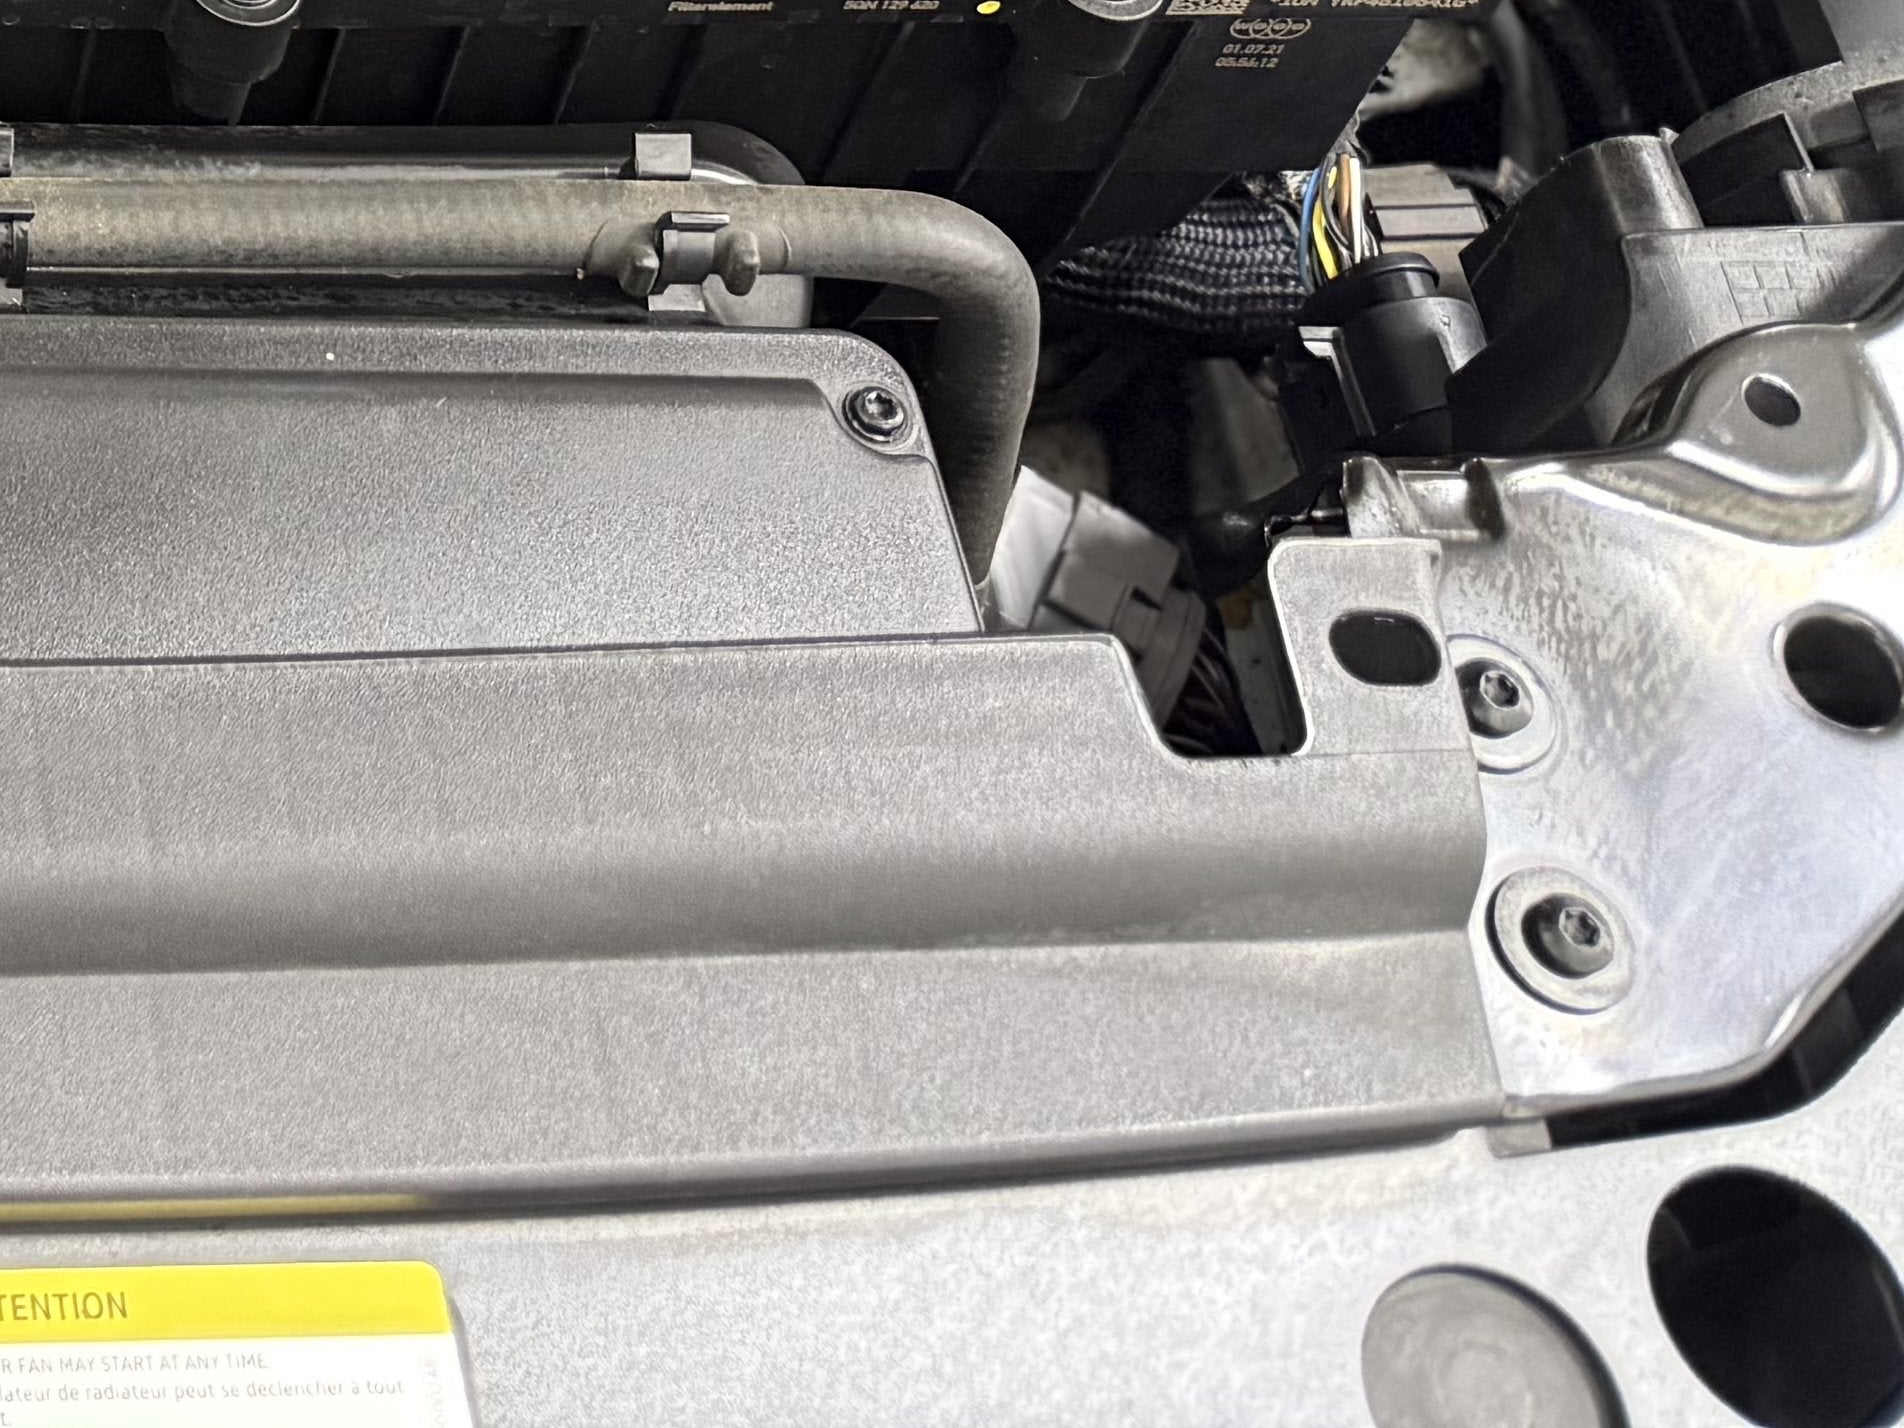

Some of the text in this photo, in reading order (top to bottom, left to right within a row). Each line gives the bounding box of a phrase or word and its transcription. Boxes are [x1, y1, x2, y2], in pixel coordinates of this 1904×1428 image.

[18, 1356, 53, 1375] FAN
[59, 1355, 95, 1374] MAY
[101, 1354, 153, 1372] START
[159, 1354, 180, 1372] AT
[185, 1353, 219, 1371] ANY
[58, 1383, 80, 1402] de
[85, 1380, 168, 1401] radiateur
[173, 1382, 217, 1403] peut
[221, 1383, 240, 1398] se
[366, 1379, 404, 1396] tout
